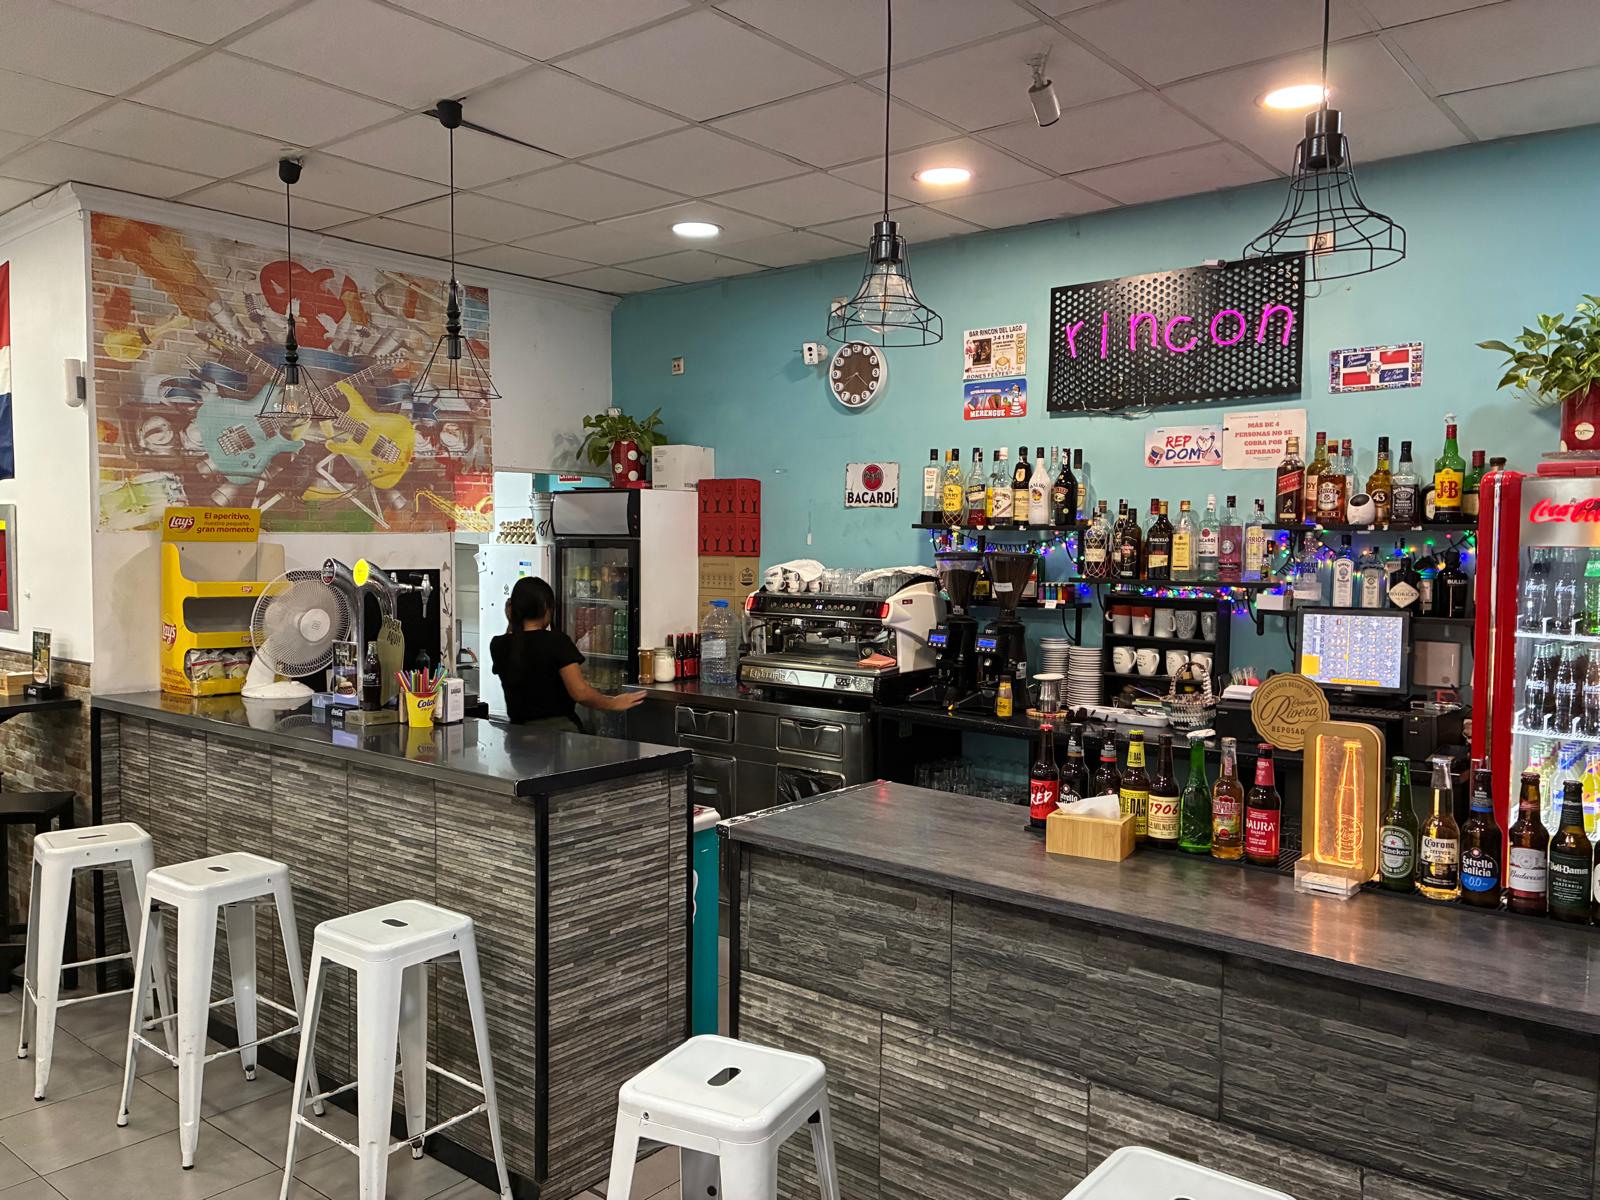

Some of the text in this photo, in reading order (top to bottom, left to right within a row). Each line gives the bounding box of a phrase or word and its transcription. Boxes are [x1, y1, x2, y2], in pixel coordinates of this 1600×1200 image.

[980, 328, 999, 336] RINCON
[999, 326, 1008, 334] DEL
[1066, 303, 1294, 359] rincon
[970, 409, 1006, 418] MERENGUE
[1234, 430, 1271, 438] PERSONAS
[1271, 429, 1283, 437] NO
[1165, 435, 1192, 449] REP
[1243, 439, 1267, 447] COBRA
[1165, 447, 1201, 461] DOM
[1307, 482, 1316, 490] DY
[847, 488, 896, 504] BACARDÍ
[1373, 492, 1386, 502] 43
[204, 512, 251, 521] El aperitivo,
[1260, 695, 1319, 726] Rivera
[1272, 725, 1305, 735] REPOSAD
[1031, 790, 1053, 805] RED
[1149, 802, 1179, 816] 1906
[1424, 837, 1455, 849] Corona
[1462, 855, 1493, 869] Estrella
[1462, 865, 1492, 878] Galicia
